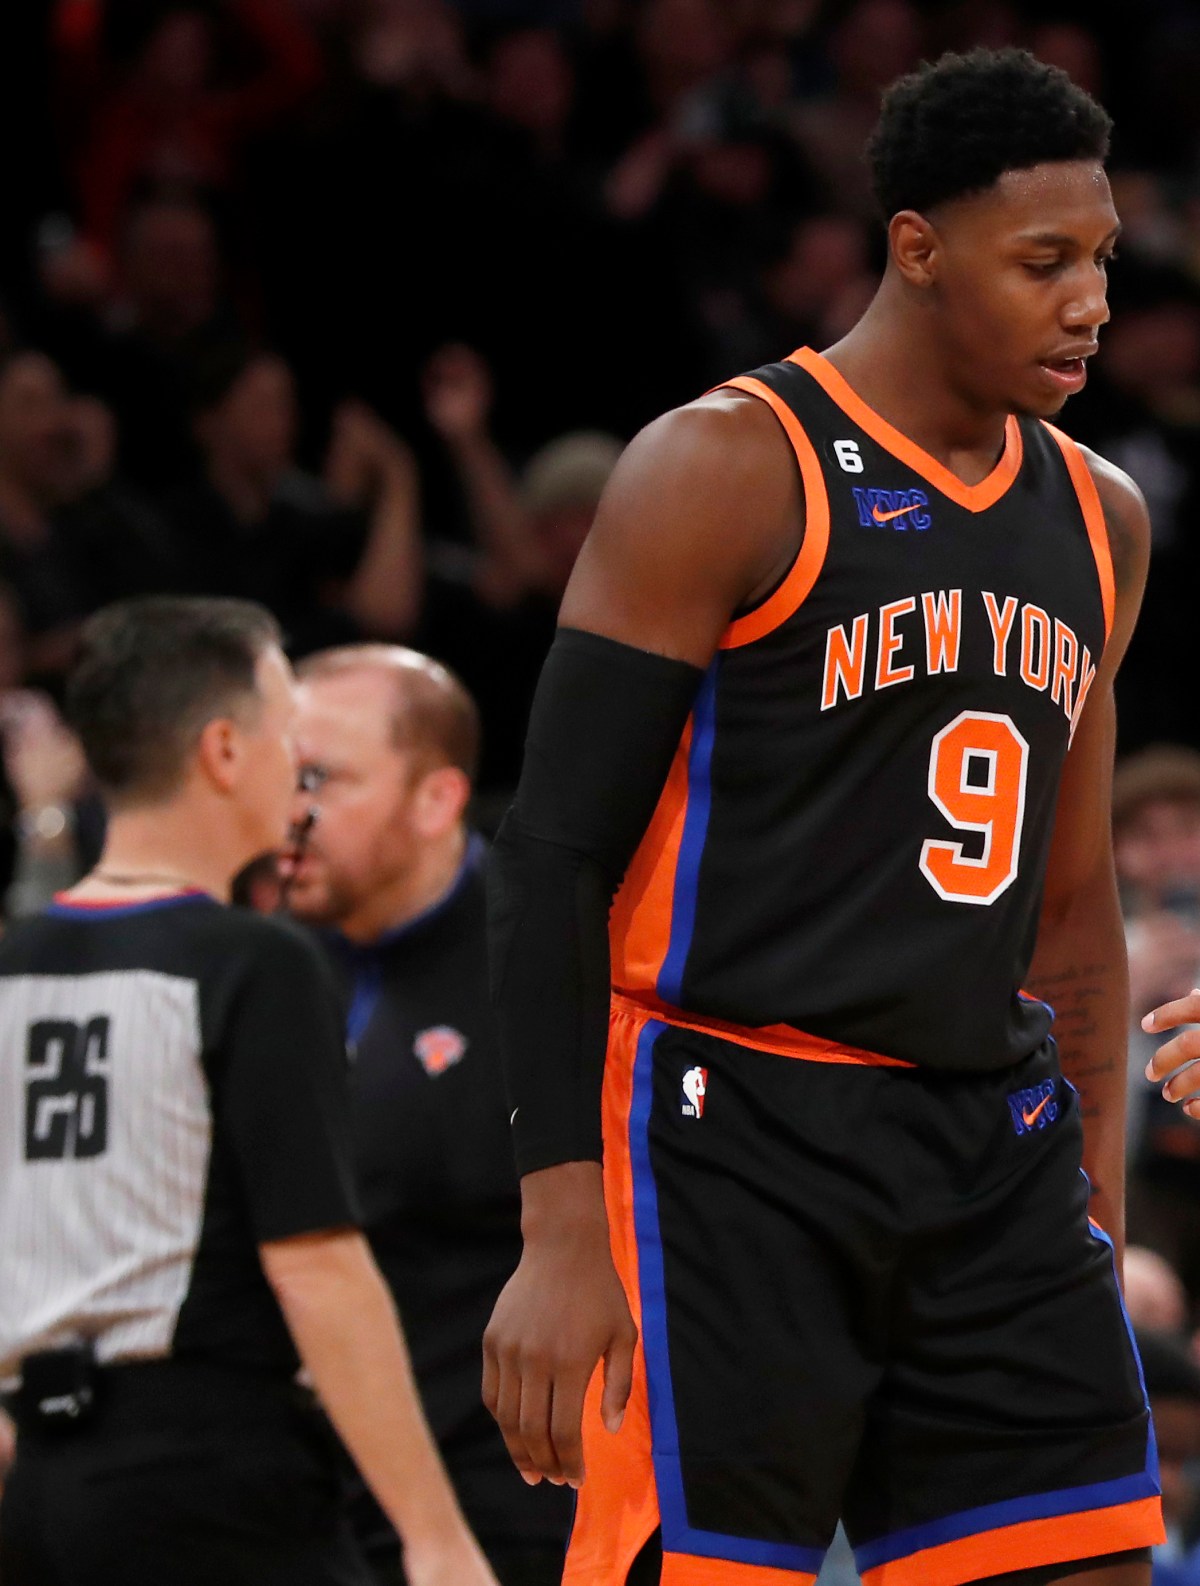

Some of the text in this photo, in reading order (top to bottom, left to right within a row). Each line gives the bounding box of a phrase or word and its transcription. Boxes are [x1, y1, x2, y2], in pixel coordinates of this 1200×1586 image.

[833, 439, 865, 474] 6
[852, 486, 932, 531] NYC
[820, 589, 1096, 751] NEW YORK
[919, 709, 1030, 907] 9
[26, 1016, 108, 1159] 26
[1007, 1078, 1058, 1136] NYC
